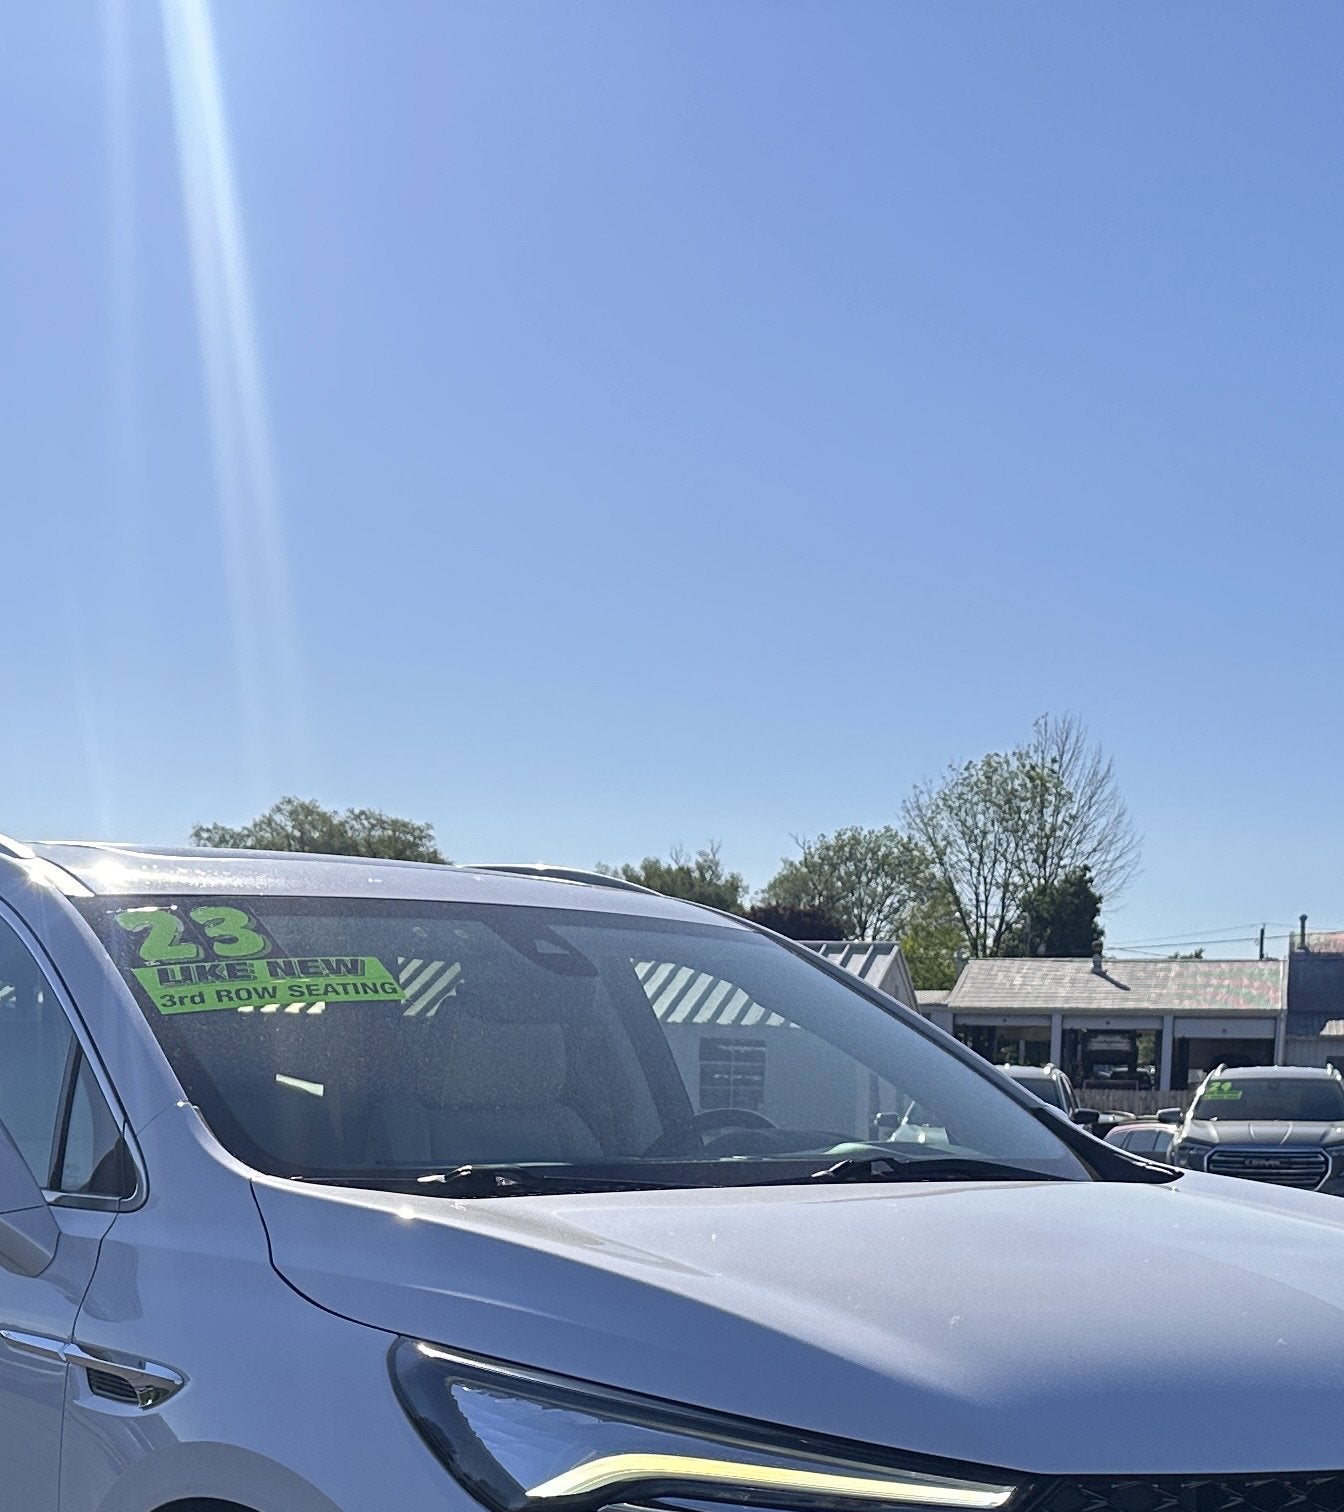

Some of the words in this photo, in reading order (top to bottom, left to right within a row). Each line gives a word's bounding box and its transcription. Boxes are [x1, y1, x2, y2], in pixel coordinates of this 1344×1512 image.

[114, 906, 272, 960] 23
[156, 961, 256, 987] LIKE
[260, 957, 366, 981] NEW
[159, 989, 205, 1008] 3rd
[215, 985, 277, 1002] ROW
[288, 981, 398, 998] SEATING
